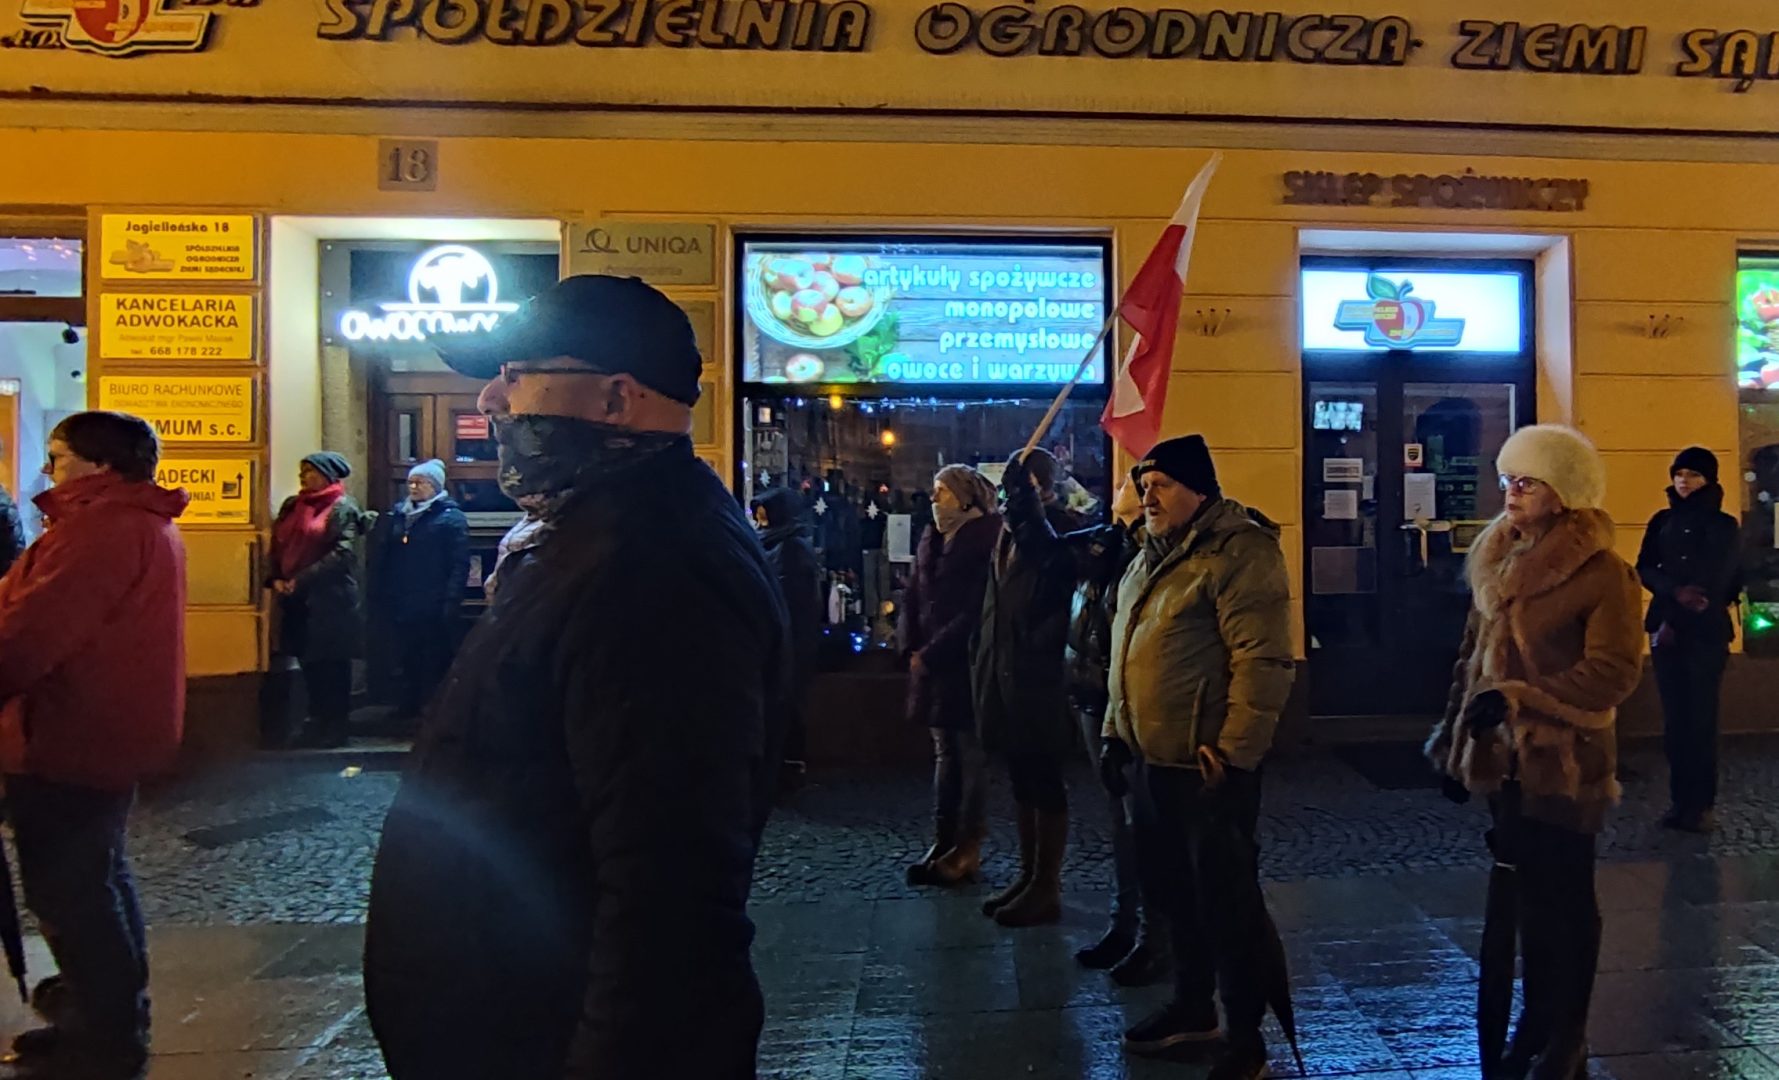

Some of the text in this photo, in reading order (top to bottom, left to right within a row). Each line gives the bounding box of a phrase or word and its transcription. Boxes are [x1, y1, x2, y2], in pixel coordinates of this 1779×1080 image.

[914, 2, 1410, 65] OGRODNICZA
[1450, 20, 1646, 75] ZIEMI
[214, 222, 229, 233] 18
[625, 236, 703, 255] UNIQA
[864, 264, 1096, 292] artykuły spożywcze
[116, 298, 237, 312] KANCELARIA
[945, 297, 1095, 323] monopolowe
[115, 314, 239, 328] ADWOKACKA
[939, 328, 1095, 353] przemysłowe
[150, 347, 172, 355] 668
[201, 347, 222, 356] 222
[887, 362, 963, 380] owoce
[972, 356, 979, 379] i
[110, 384, 242, 396] BIURO RACHUNKOWE
[154, 420, 241, 435] MUM s.c.
[157, 469, 215, 487] ĄDECKI
